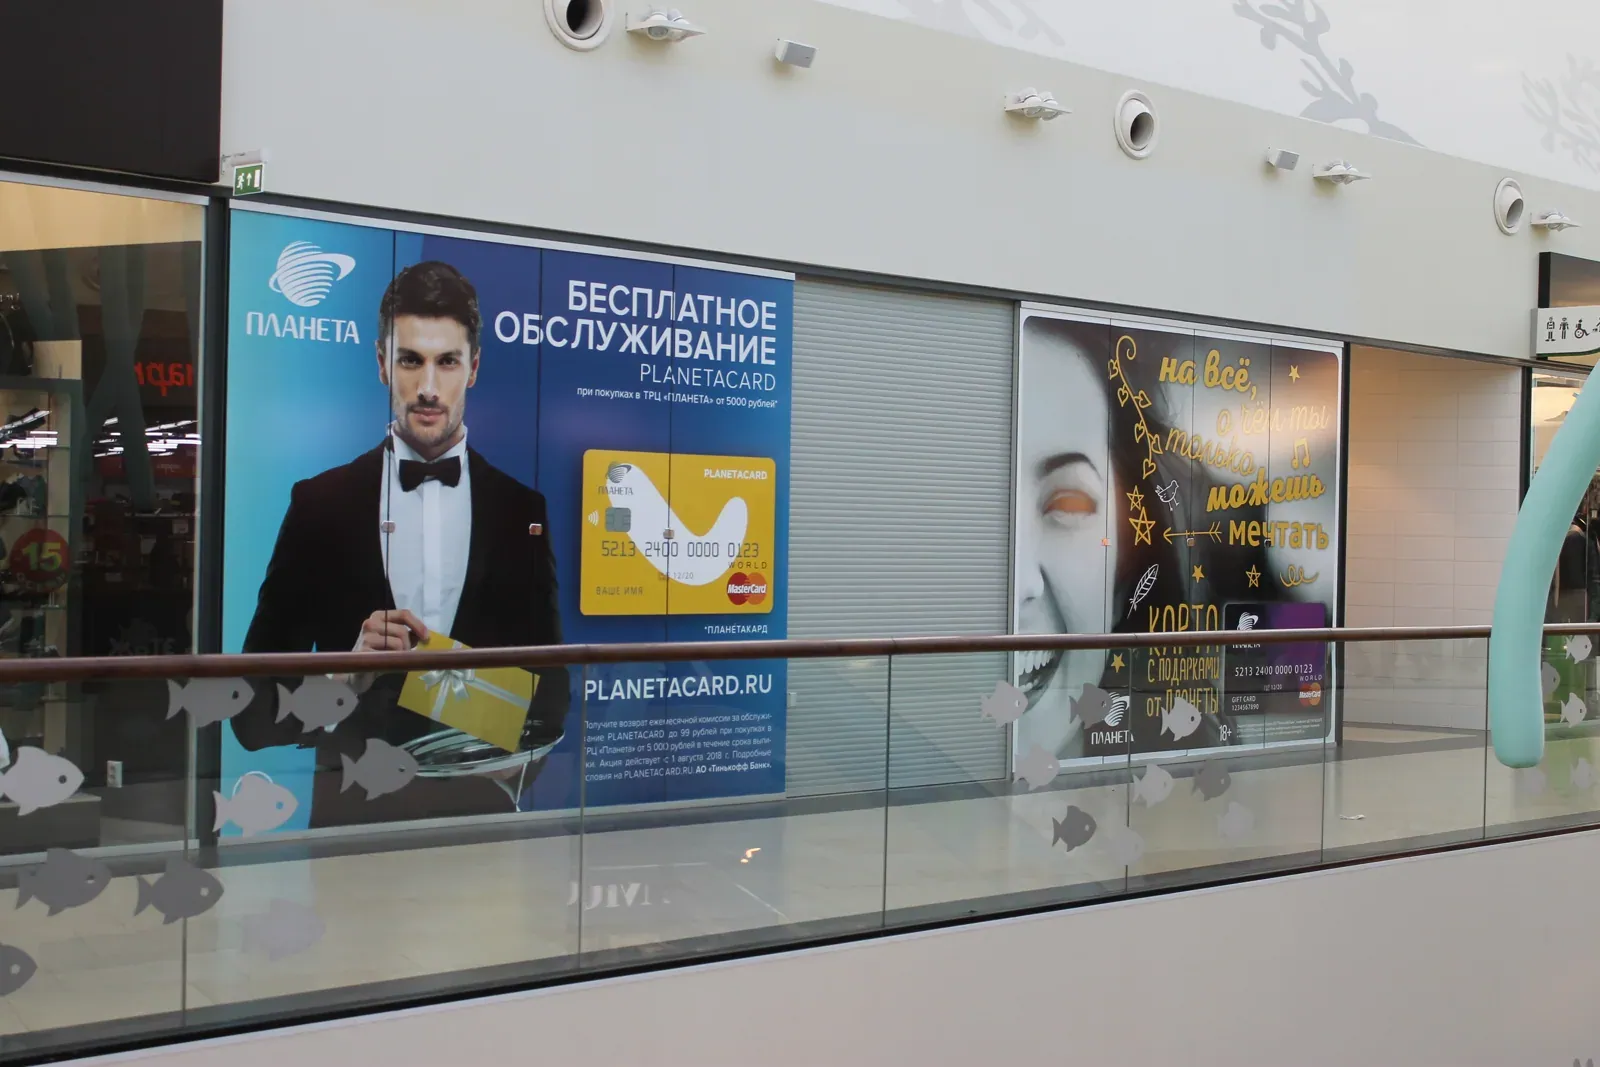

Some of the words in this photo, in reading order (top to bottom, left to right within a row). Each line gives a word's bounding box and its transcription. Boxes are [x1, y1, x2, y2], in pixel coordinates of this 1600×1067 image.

[568, 279, 777, 331] БЕСПЛАТНОЕ
[246, 311, 360, 344] ПЛАНЕТА
[494, 311, 776, 366] ОБСЛУЖИВАНИЕ
[640, 363, 776, 392] PLANETACARD
[1159, 356, 1198, 385] на
[577, 387, 593, 397] при
[595, 389, 634, 400] покупках
[643, 390, 662, 402] ТРЦ
[726, 396, 747, 407] 5000
[704, 469, 768, 480] PLANETACARD
[598, 485, 634, 496] ПЛАНЕТА
[1206, 467, 1326, 513] можешь
[22, 541, 63, 572] 15
[601, 540, 637, 557] 5213
[645, 540, 679, 558] 2400
[687, 541, 720, 558] 0000
[727, 542, 760, 558] 0123
[728, 561, 768, 570] WORLD
[596, 586, 621, 596] ВАШЕ
[624, 586, 644, 596] ИМЯ
[727, 584, 767, 594] MasterCard
[1158, 656, 1220, 687] ПОДАРКАМИ
[1234, 666, 1254, 677] 5213
[1255, 665, 1274, 676] 2400
[1274, 664, 1293, 675] 0000
[1294, 663, 1314, 674] 0123
[585, 674, 772, 701] PLANETACARD.RU
[584, 734, 605, 743] ание
[607, 729, 665, 741] PLANETACARD
[680, 728, 690, 737] 99
[692, 727, 718, 738] рублей
[1218, 724, 1233, 742] 18+
[584, 746, 598, 756] РЦ
[646, 743, 652, 752] 5
[706, 751, 723, 761] 2018
[695, 764, 707, 774] АО
